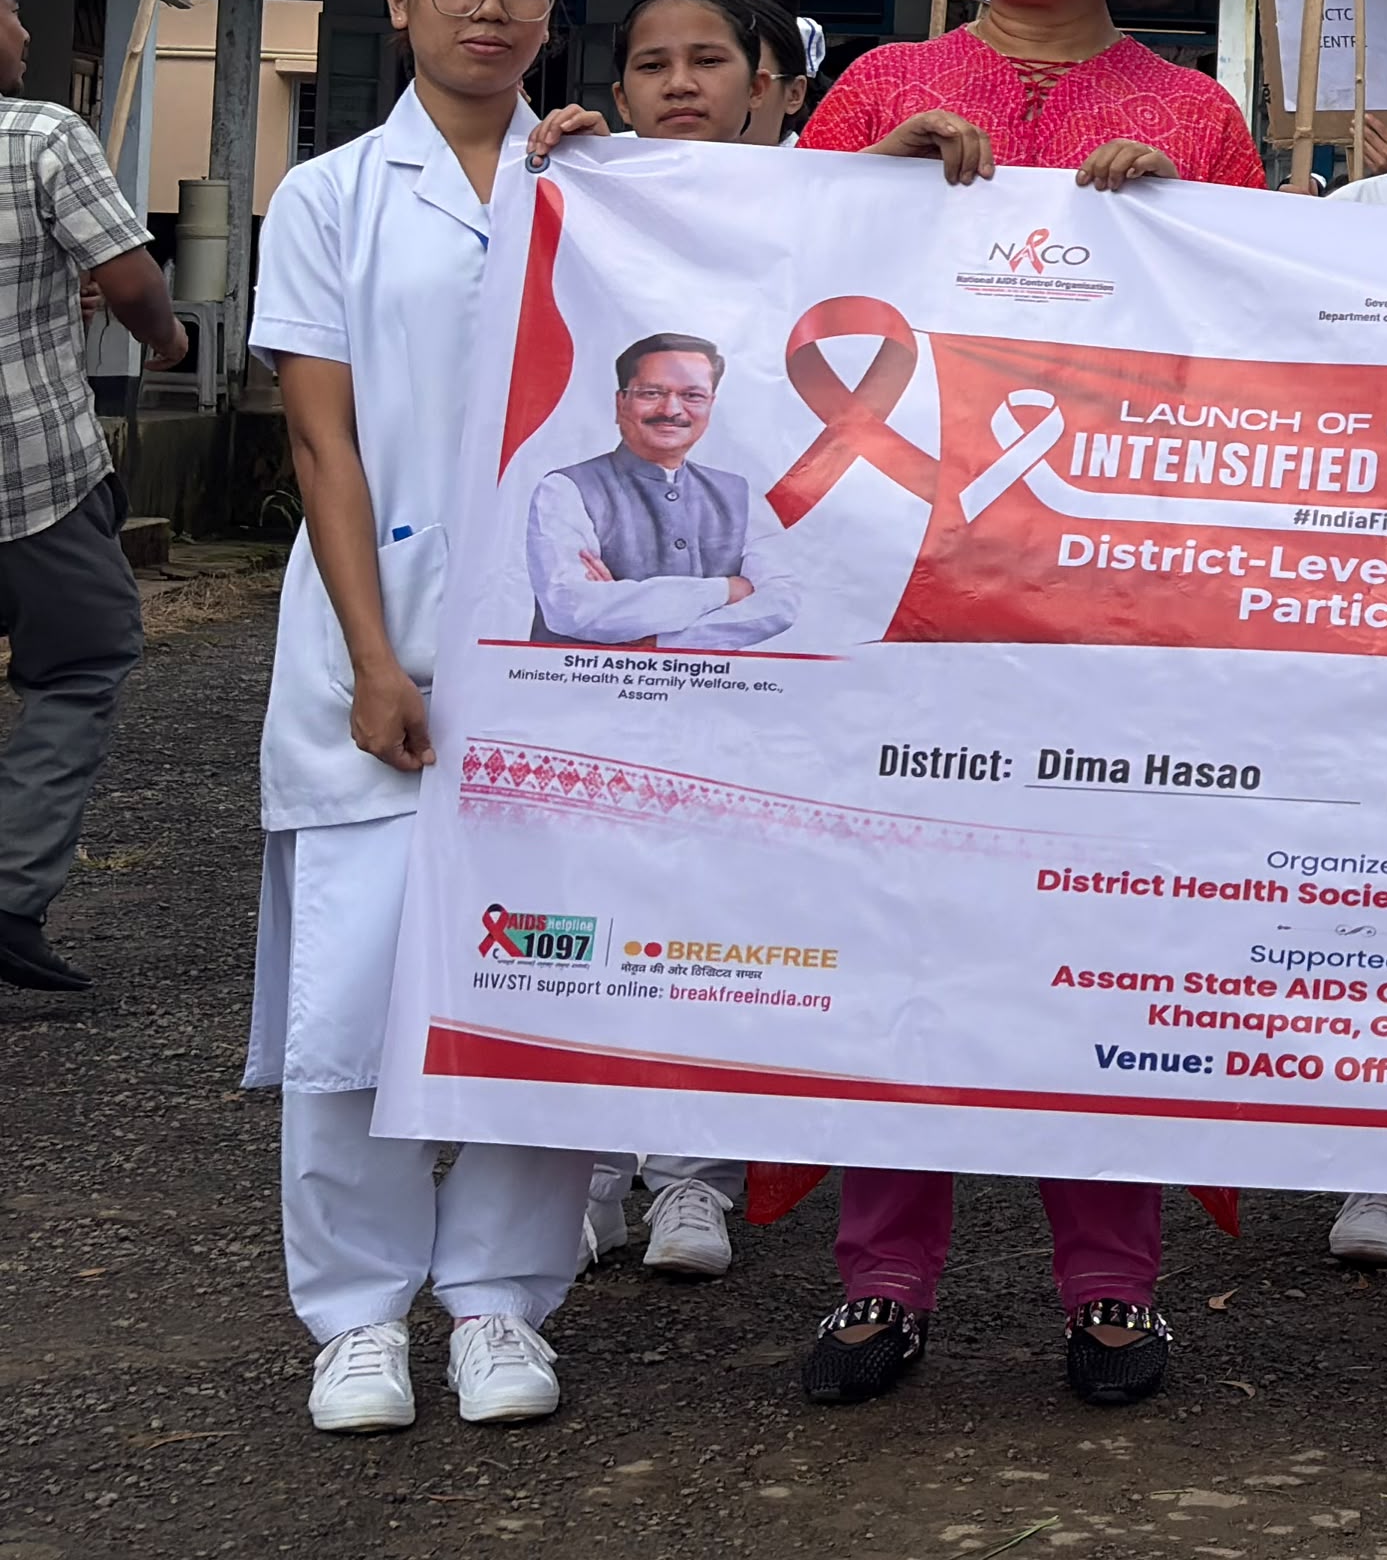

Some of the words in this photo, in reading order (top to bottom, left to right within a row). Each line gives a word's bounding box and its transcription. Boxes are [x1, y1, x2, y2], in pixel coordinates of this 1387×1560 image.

[989, 233, 1090, 271] NACO
[1319, 311, 1380, 322] Department
[1119, 400, 1301, 434] LAUNCH
[1317, 411, 1371, 436] OF
[1070, 431, 1379, 494] INTENSIFIED
[508, 669, 568, 684] Minister,
[572, 673, 619, 685] Health
[623, 675, 633, 685] &
[638, 676, 687, 690] Family
[690, 678, 749, 692] Welfare,
[753, 681, 784, 694] etc.,
[564, 655, 598, 669] Shri
[602, 657, 658, 672] Ashok
[662, 659, 730, 676] Singhal
[618, 689, 668, 702] Assam
[879, 744, 1013, 782] District:
[1037, 749, 1130, 784] Dima
[1144, 754, 1261, 791] Hasao
[1036, 869, 1164, 897] District
[1173, 876, 1289, 904] Health
[507, 913, 548, 931] AIDS
[523, 932, 591, 961] 1097
[667, 940, 839, 969] BREAKFREE
[473, 972, 532, 991] HIV/STI
[537, 979, 601, 998] support
[606, 982, 664, 999] online:
[669, 984, 831, 1011] breakfreeindia.org
[1051, 965, 1176, 994] Assam
[1183, 971, 1277, 999] State
[1284, 976, 1370, 1004] AIDS
[1148, 1004, 1361, 1040] Khanapara,
[1094, 1044, 1214, 1075] Venue:
[1225, 1050, 1324, 1081] DACO
